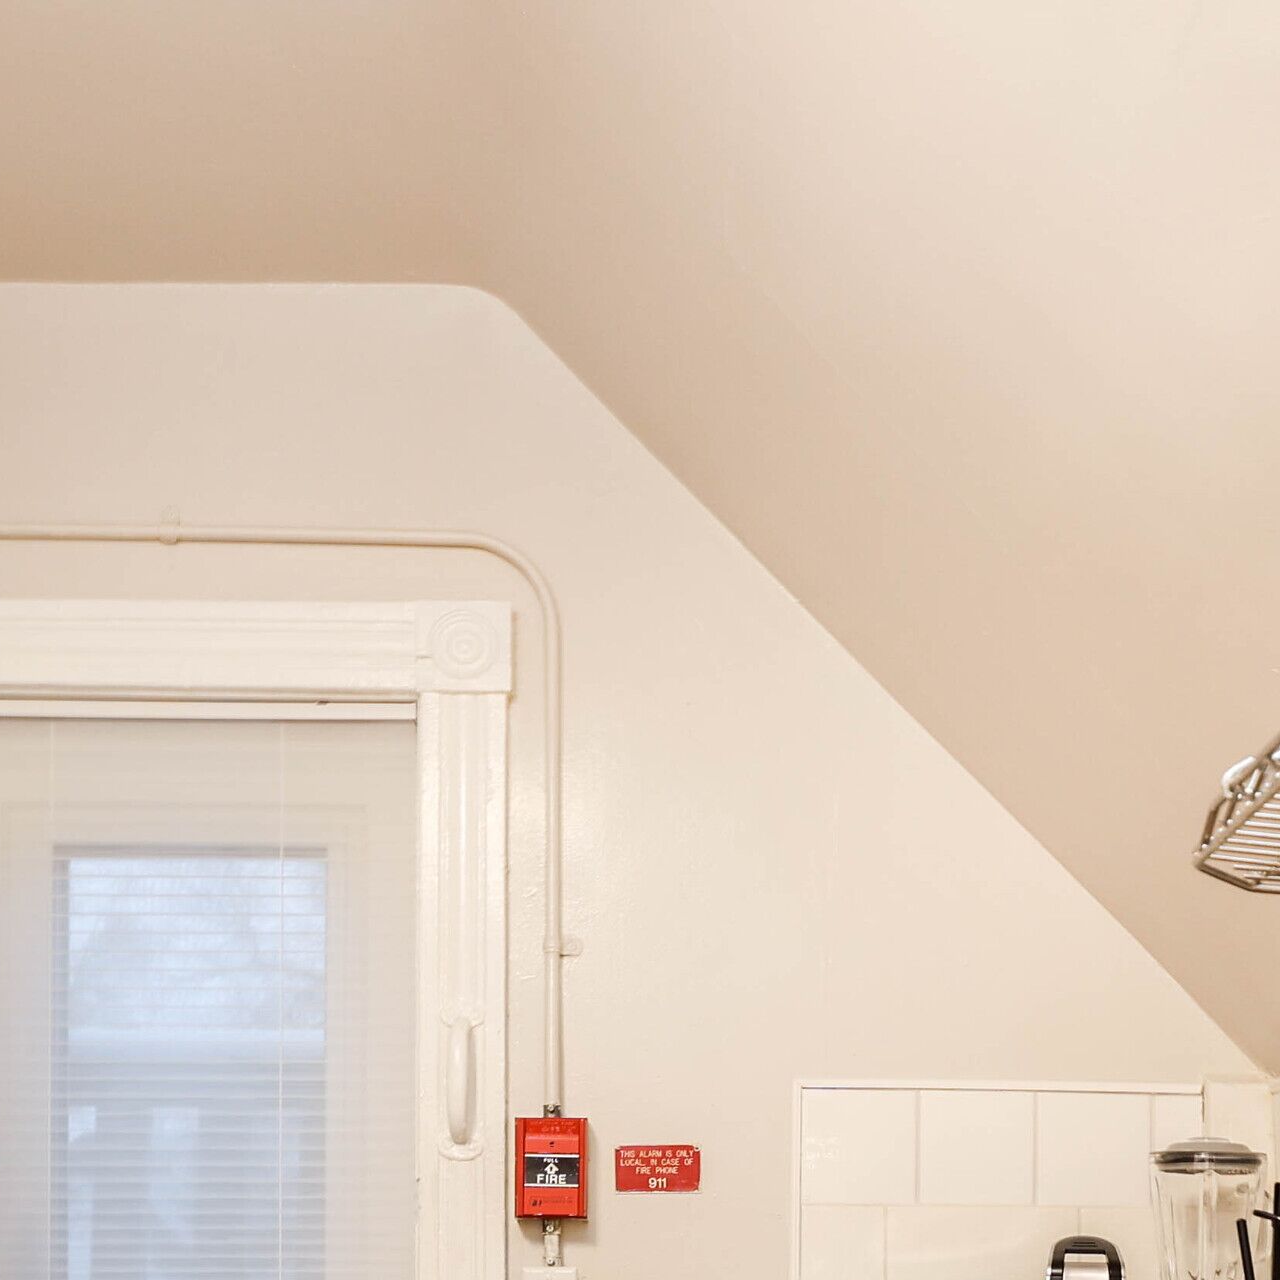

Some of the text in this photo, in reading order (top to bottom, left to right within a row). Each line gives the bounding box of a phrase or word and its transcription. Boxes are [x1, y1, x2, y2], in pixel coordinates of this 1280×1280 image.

[620, 1150, 635, 1158] THIS
[639, 1150, 662, 1158] ALARM
[665, 1150, 673, 1158] IS
[661, 1158, 679, 1166] CASE
[684, 1158, 694, 1166] OF
[536, 1174, 567, 1185] FIRE
[648, 1177, 667, 1188] 911
